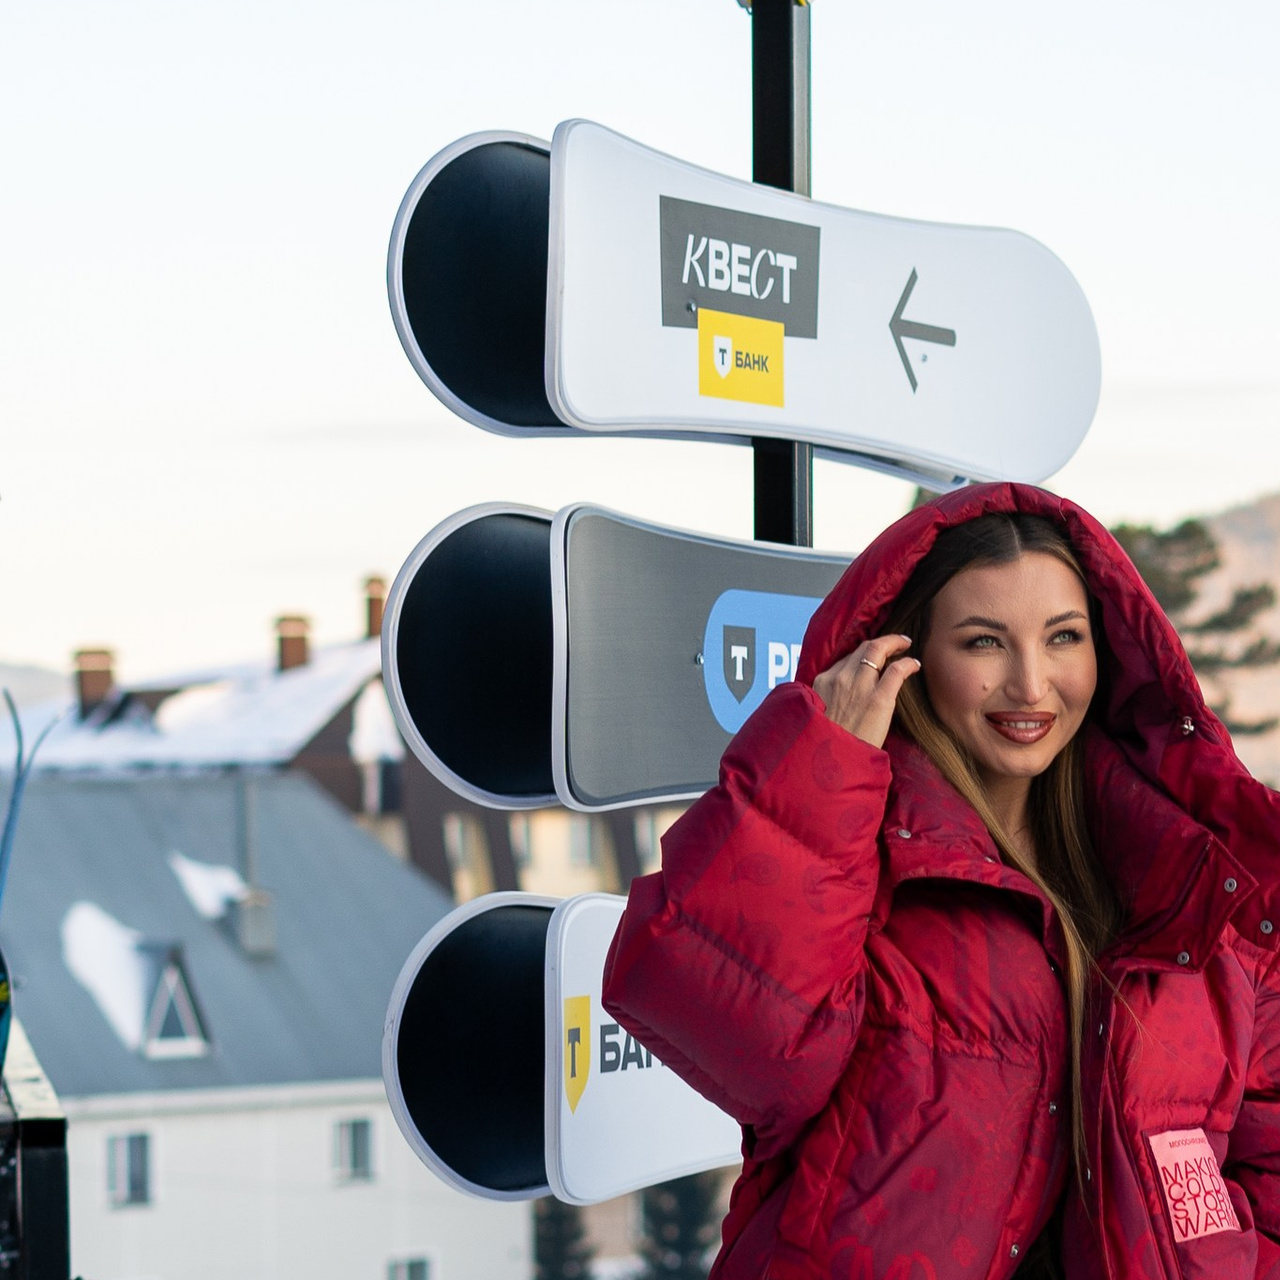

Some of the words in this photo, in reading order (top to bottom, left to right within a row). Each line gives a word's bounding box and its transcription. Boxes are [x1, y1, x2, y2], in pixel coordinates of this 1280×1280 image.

[682, 234, 797, 304] КВЕСТ
[735, 350, 769, 373] БАНК
[1168, 1174, 1221, 1202] COLD
